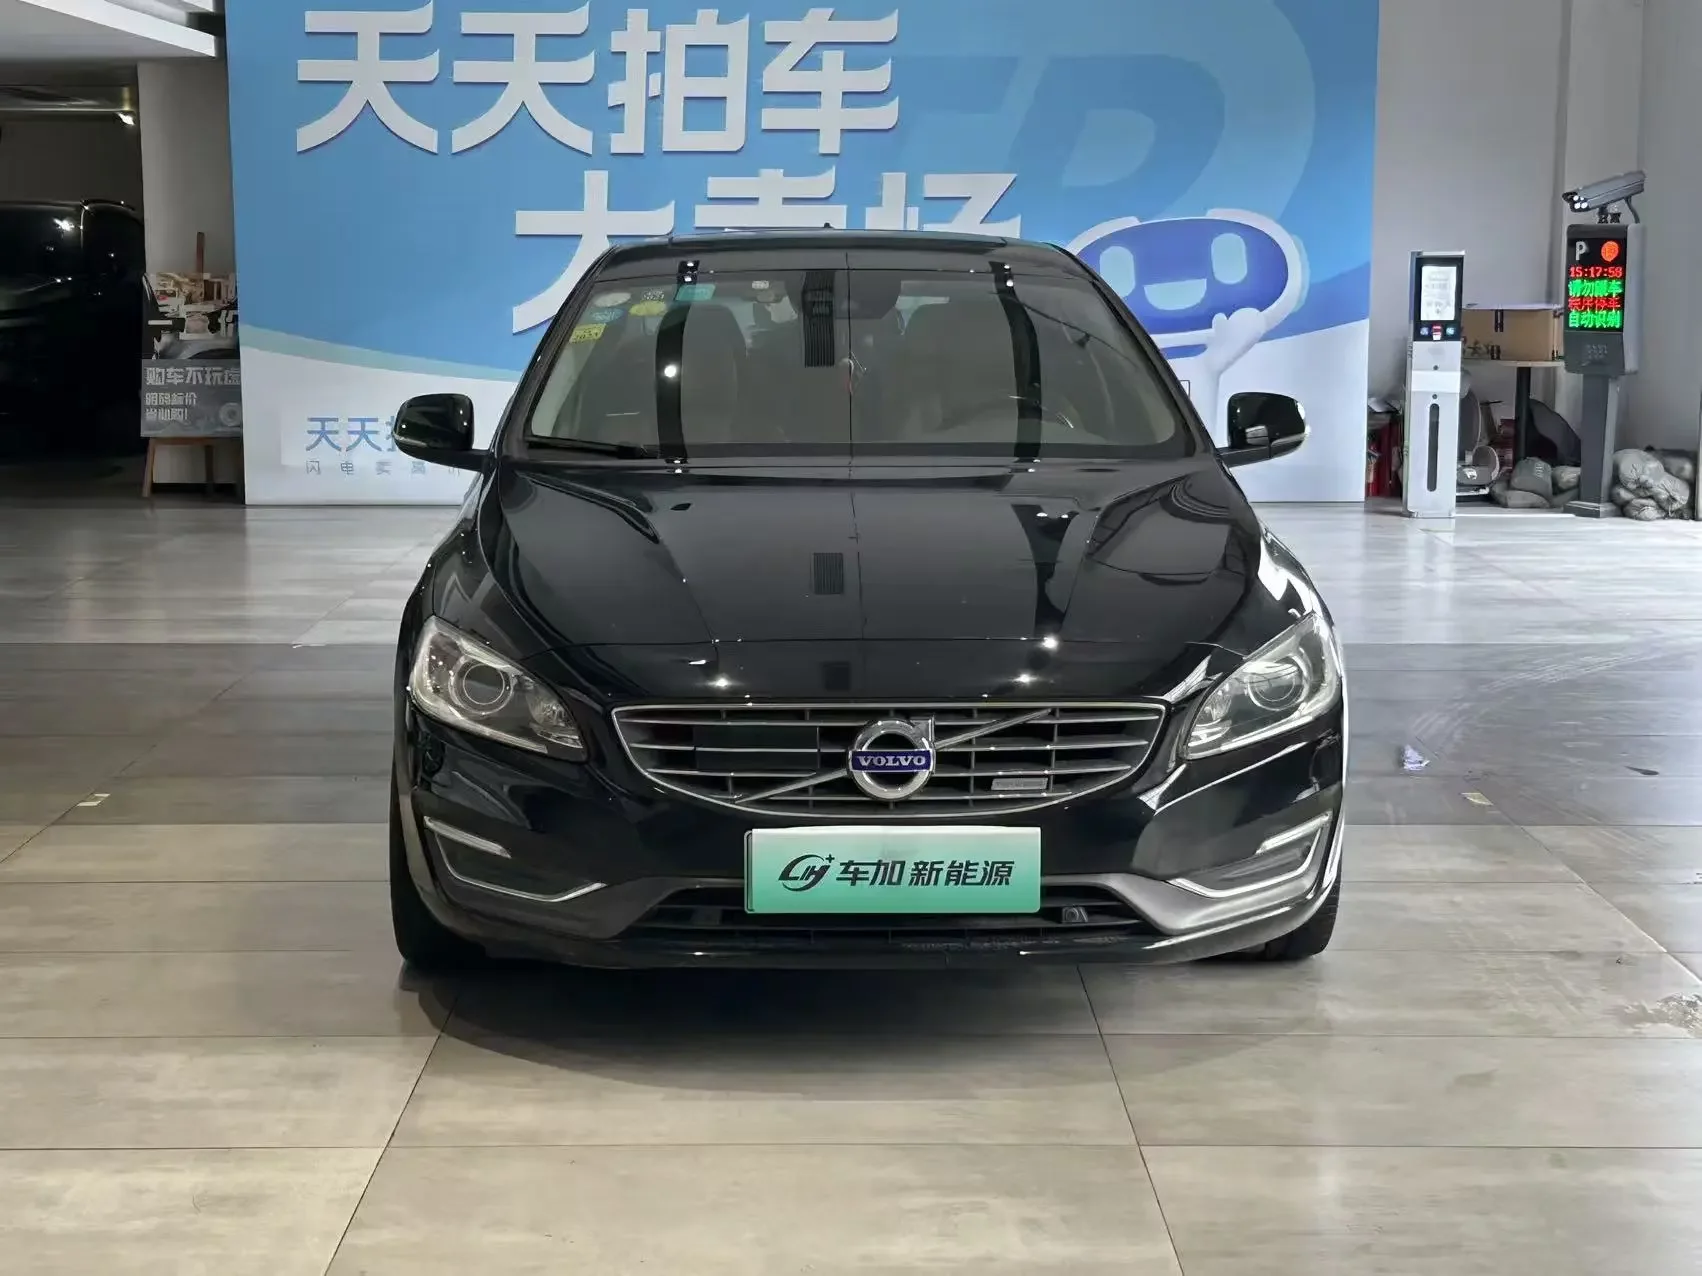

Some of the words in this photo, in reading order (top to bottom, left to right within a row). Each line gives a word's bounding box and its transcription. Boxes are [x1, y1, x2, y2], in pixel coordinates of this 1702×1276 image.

[297, 0, 899, 155] 天天拍车
[1575, 241, 1587, 261] P
[1568, 310, 1621, 328] 自动识别
[305, 415, 398, 452] 天天
[857, 755, 926, 767] VOLVO
[836, 859, 1014, 886] 车加新能源
